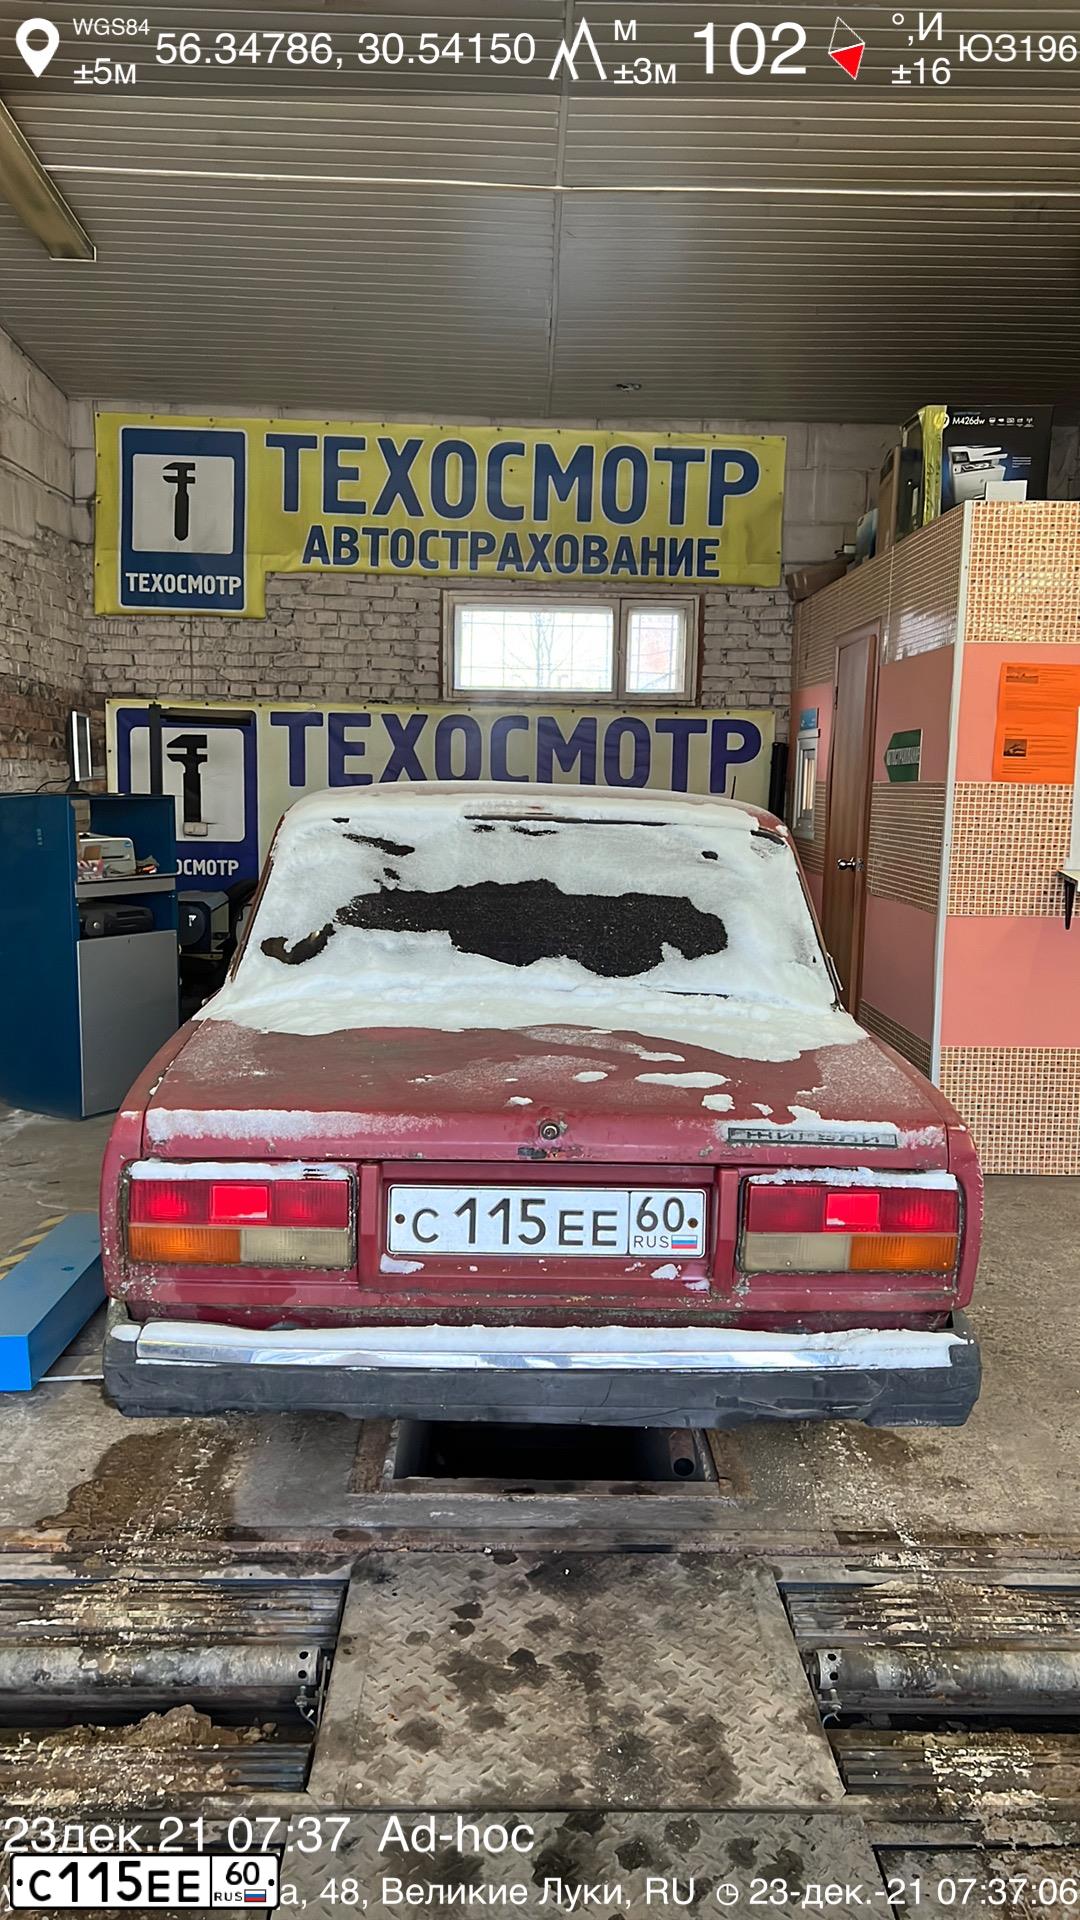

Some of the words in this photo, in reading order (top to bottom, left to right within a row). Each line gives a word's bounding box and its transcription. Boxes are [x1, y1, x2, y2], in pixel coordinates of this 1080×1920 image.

[952, 416, 986, 426] M426dw
[265, 433, 760, 528] ТЕХОСМОТР
[302, 525, 720, 578] АВТОСТРАХОВАНИЕ
[125, 572, 242, 596] ТЕХОСМОТР
[270, 711, 762, 794] ТЕХОСМОТР
[176, 858, 240, 876] ОСМОТР
[636, 1196, 685, 1232] 60
[633, 1235, 669, 1248] RUS
